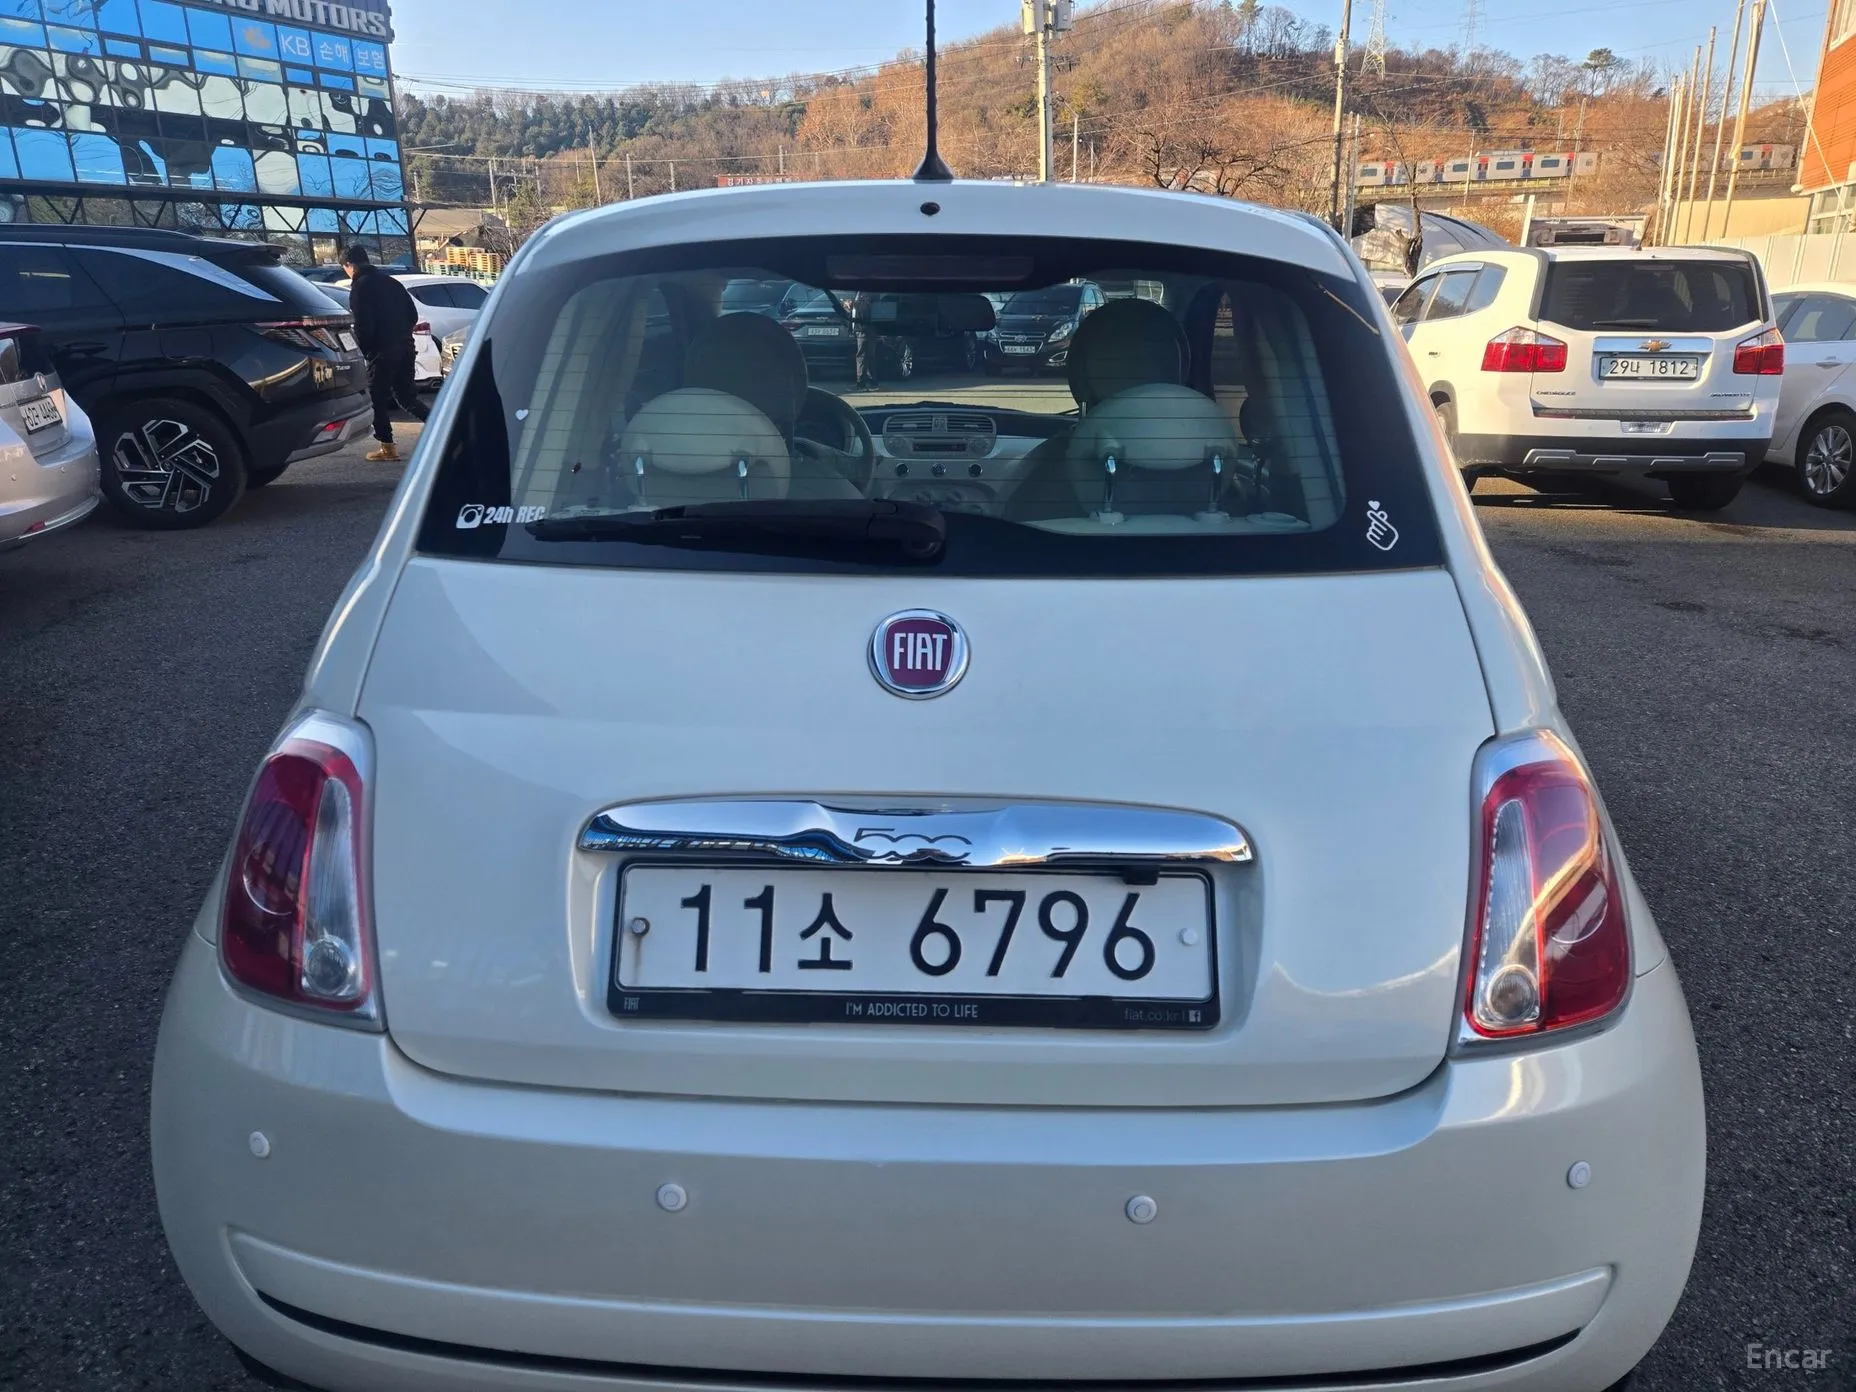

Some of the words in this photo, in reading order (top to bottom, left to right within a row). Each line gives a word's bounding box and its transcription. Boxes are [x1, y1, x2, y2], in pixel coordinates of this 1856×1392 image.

[266, 0, 386, 37] MOTORS
[280, 34, 310, 57] KB
[1609, 360, 1640, 374] 29나
[1650, 360, 1689, 375] 1812
[483, 506, 514, 524] 24h
[515, 506, 546, 523] REC
[893, 632, 948, 671] FIAT
[680, 884, 853, 972] 11소
[909, 888, 1156, 981] 6796
[846, 1002, 863, 1015] I'M
[867, 1003, 928, 1017] ADDICTED
[932, 1004, 950, 1017] TO
[954, 1004, 978, 1018] LIFE
